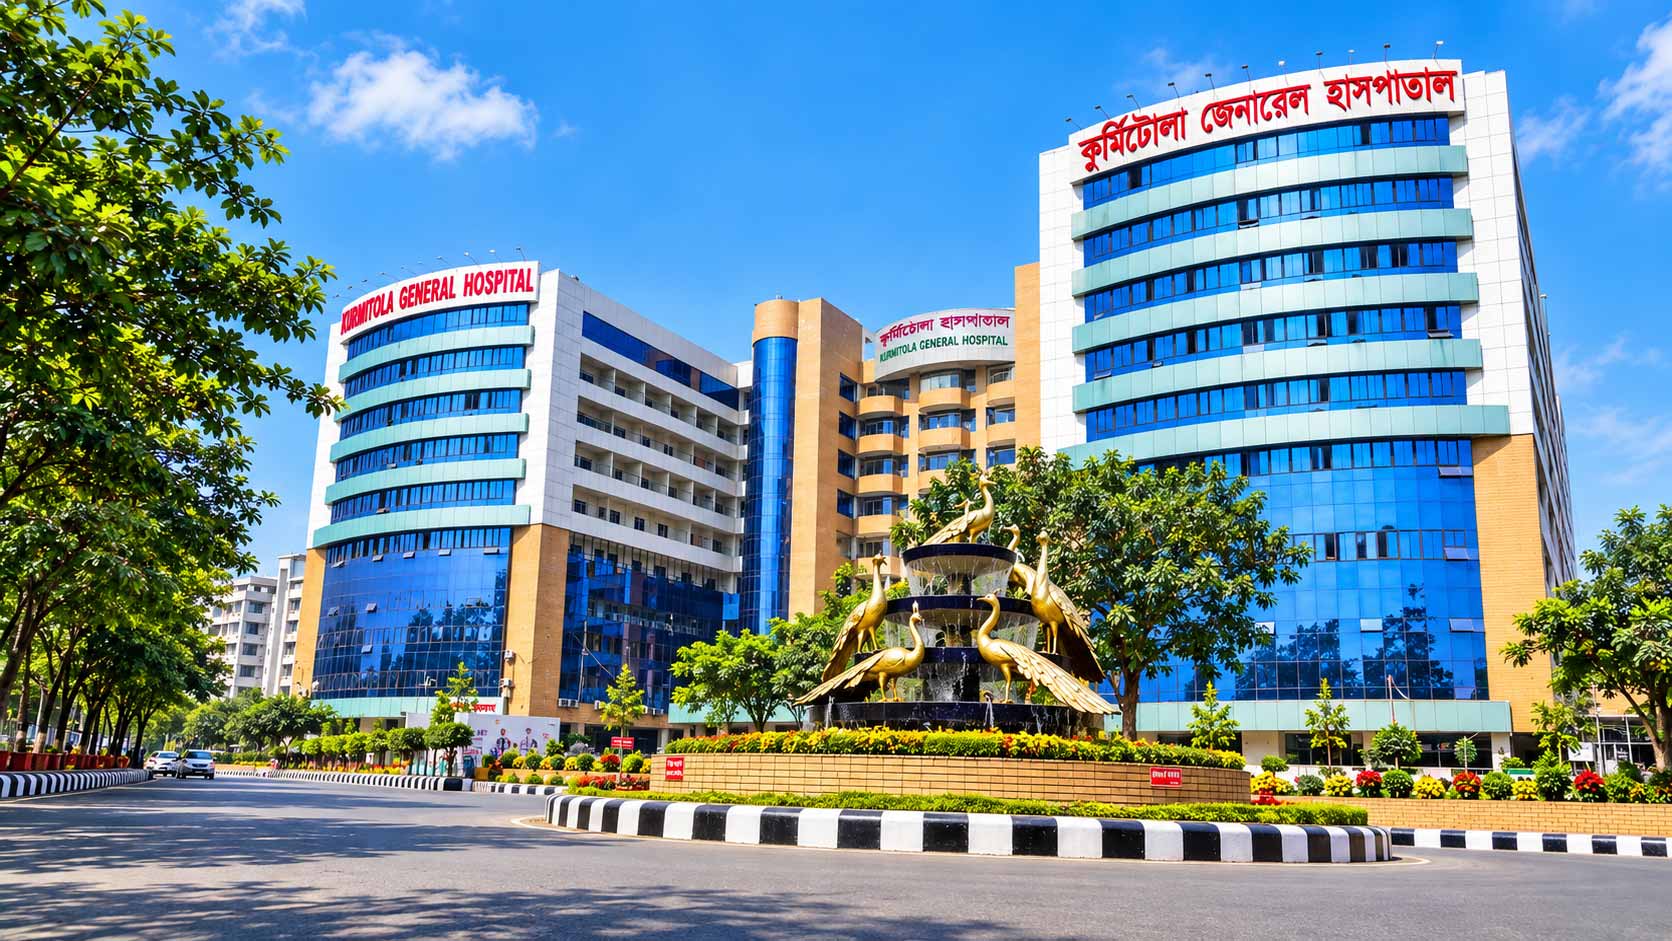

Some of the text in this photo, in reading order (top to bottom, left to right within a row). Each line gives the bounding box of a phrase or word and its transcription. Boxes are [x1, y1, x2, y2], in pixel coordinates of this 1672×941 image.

[1078, 66, 1458, 172] কুর্মিটোলা জেনারেল হাসপাতাল
[340, 267, 534, 336] KURMITOLA GENERAL HOSPITAL
[940, 313, 1010, 331] হাসপাতাল
[919, 336, 959, 350] GENERAL
[962, 335, 1008, 346] HOSPITAL
